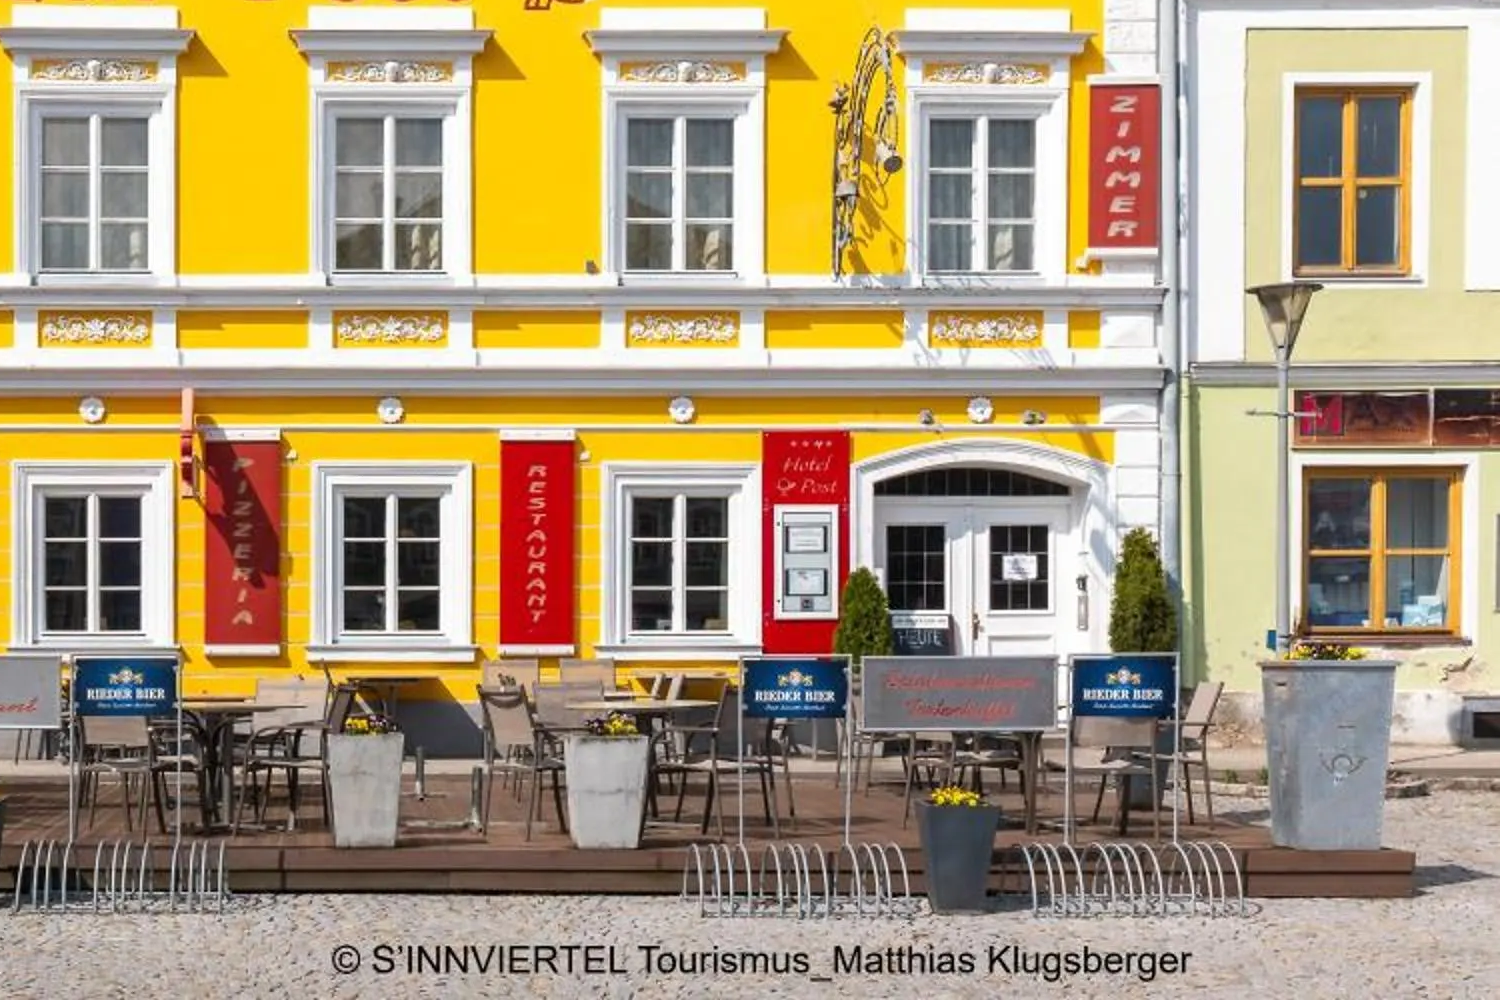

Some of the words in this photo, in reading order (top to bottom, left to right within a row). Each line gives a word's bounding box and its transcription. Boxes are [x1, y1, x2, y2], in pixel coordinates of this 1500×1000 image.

[1104, 96, 1142, 237] ZIMMER
[783, 454, 834, 473] Hotel
[801, 478, 837, 494] Post
[232, 457, 254, 625] PIZZERIA
[526, 465, 548, 623] RESTAURANT
[87, 687, 132, 700] RIEDER
[135, 687, 165, 700] BIER
[755, 690, 801, 702] RIEDER
[805, 690, 835, 702] BIER
[1083, 688, 1130, 700] RIEDER
[1133, 688, 1163, 700] BIER
